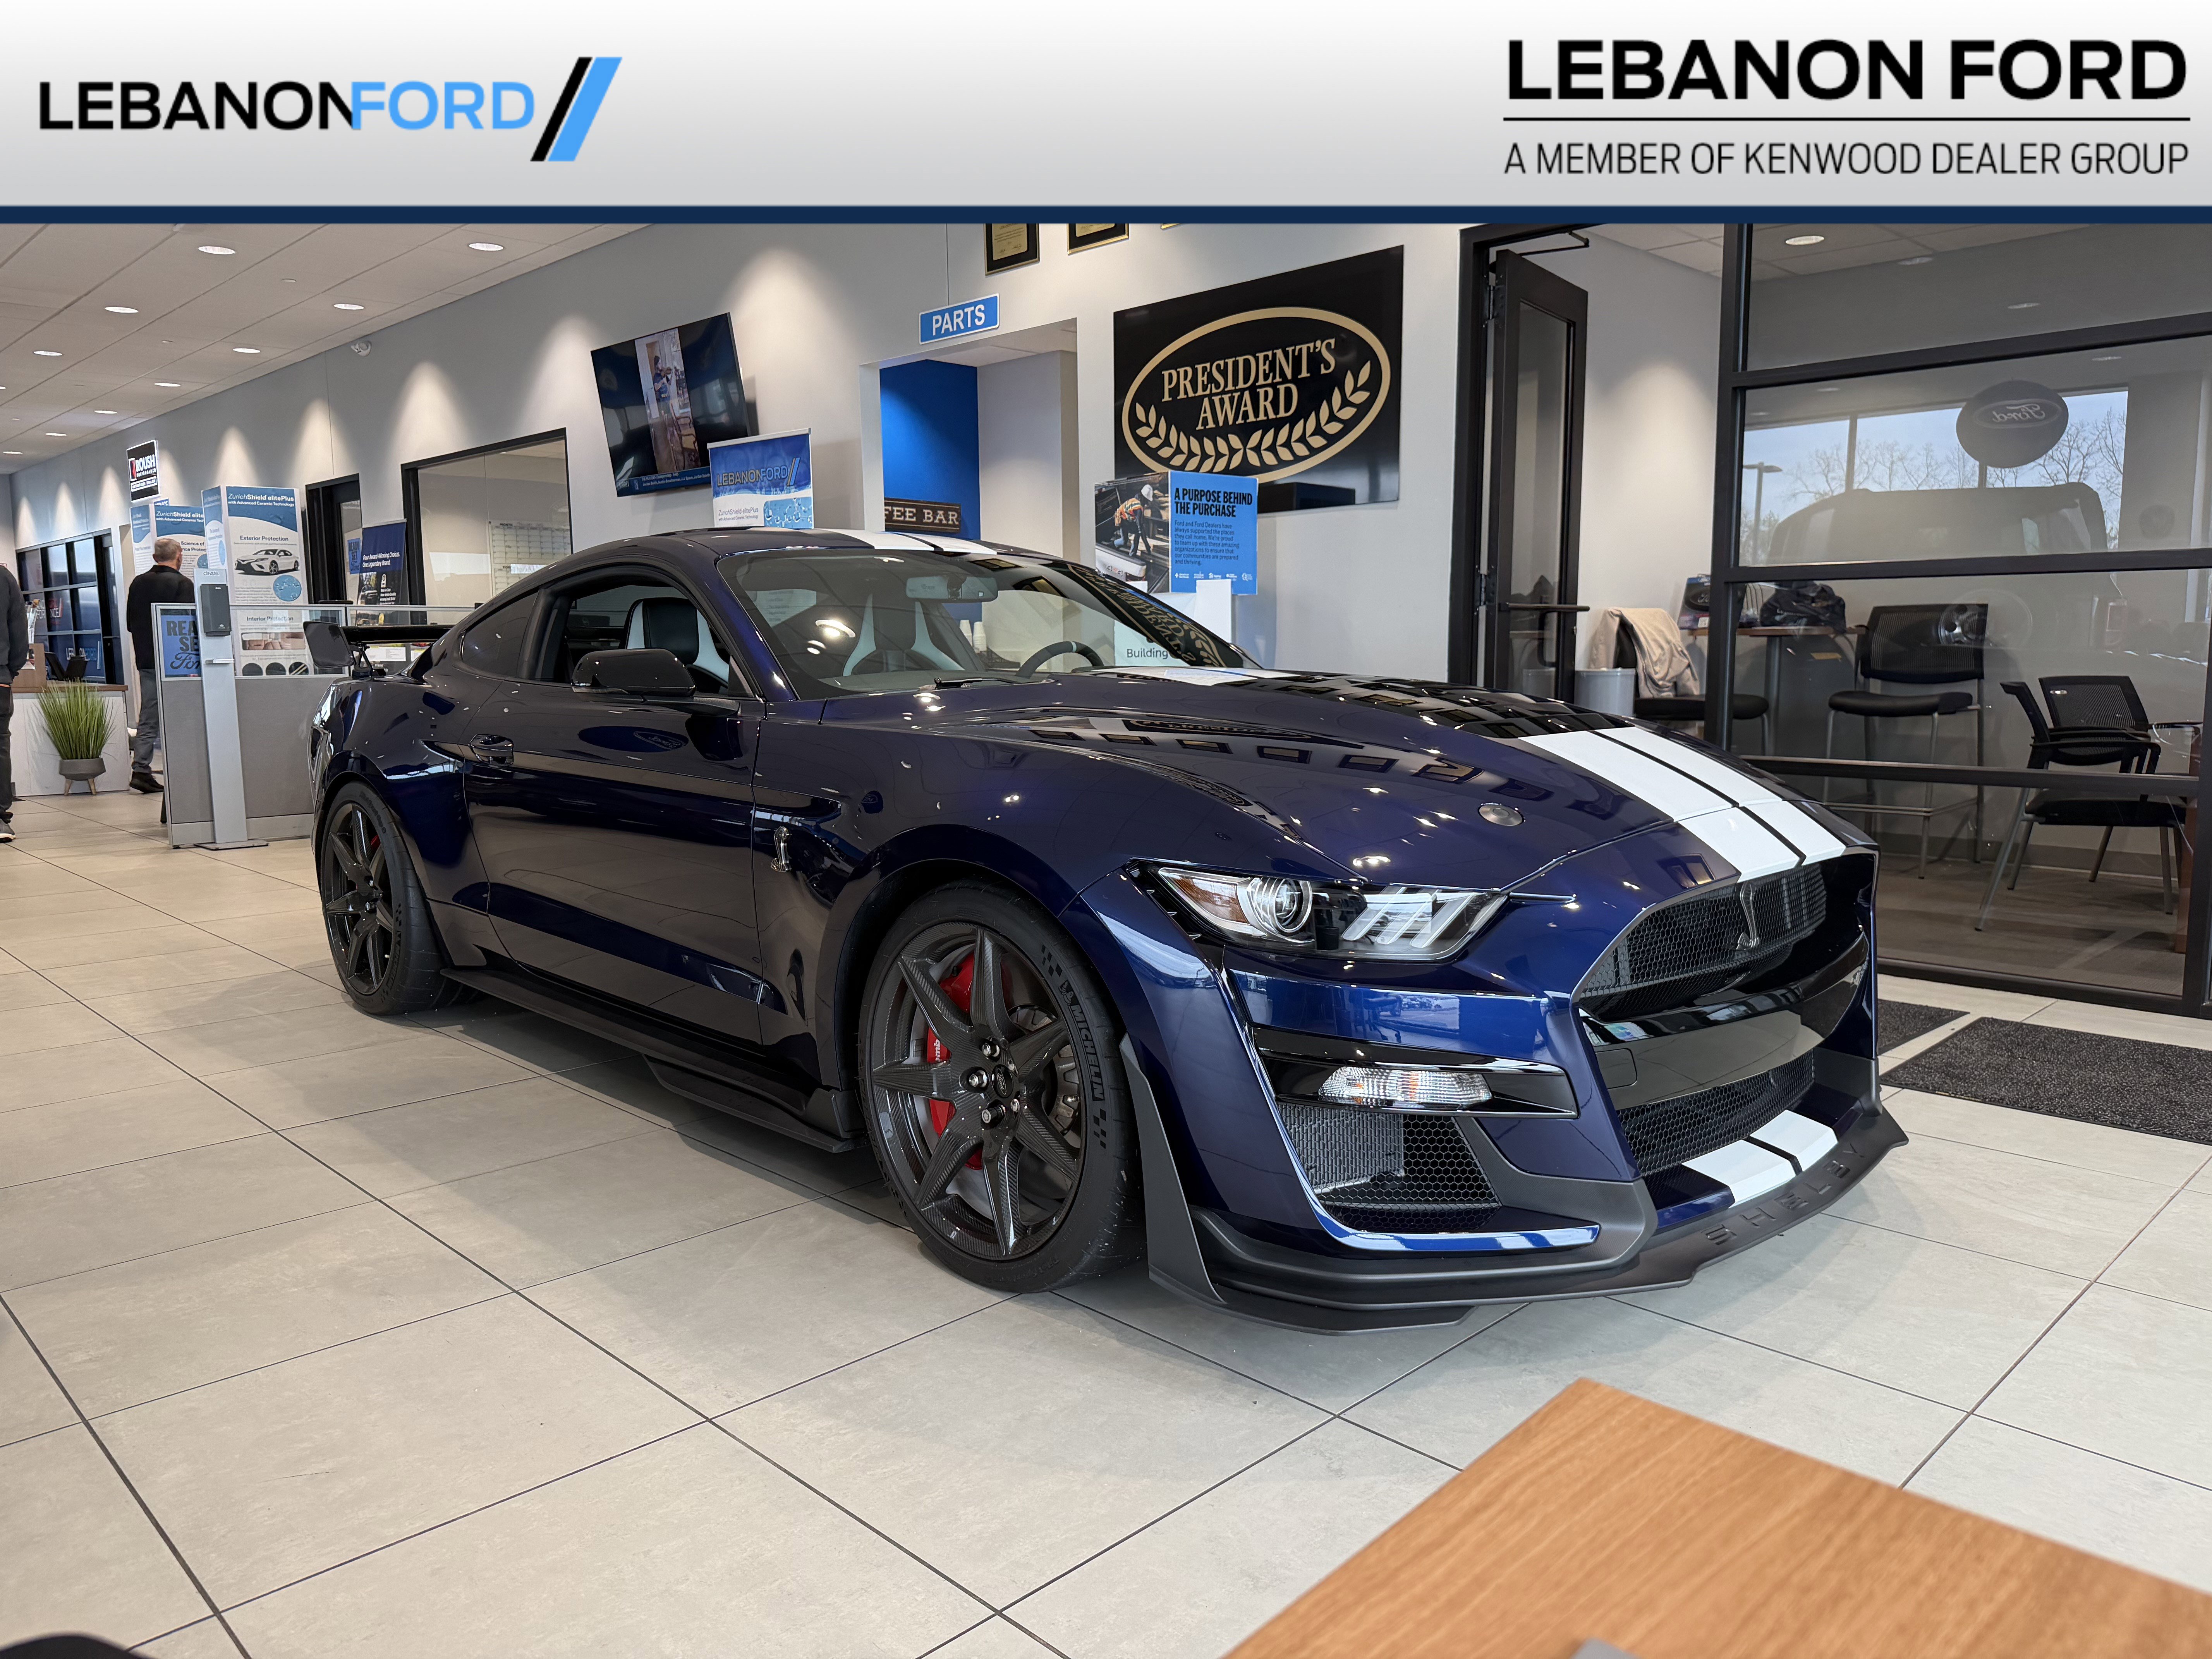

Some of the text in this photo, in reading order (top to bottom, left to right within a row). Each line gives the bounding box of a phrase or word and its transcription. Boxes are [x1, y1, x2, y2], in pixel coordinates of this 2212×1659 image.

[932, 304, 985, 336] PARTS
[1162, 338, 1336, 402] PRESIDENT'S
[1196, 383, 1298, 431] AWARD
[135, 454, 156, 472] ROUSH
[1174, 488, 1253, 506] A PURPOSE BEHIND
[884, 506, 959, 524] FEE BAR
[1174, 501, 1236, 517] THE PURCHASE
[166, 620, 198, 636] REA
[179, 636, 199, 652] SE
[1127, 648, 1168, 659] Building
[1070, 1004, 1105, 1101] MICHELIN
[1702, 1143, 1866, 1246] SHELBY
